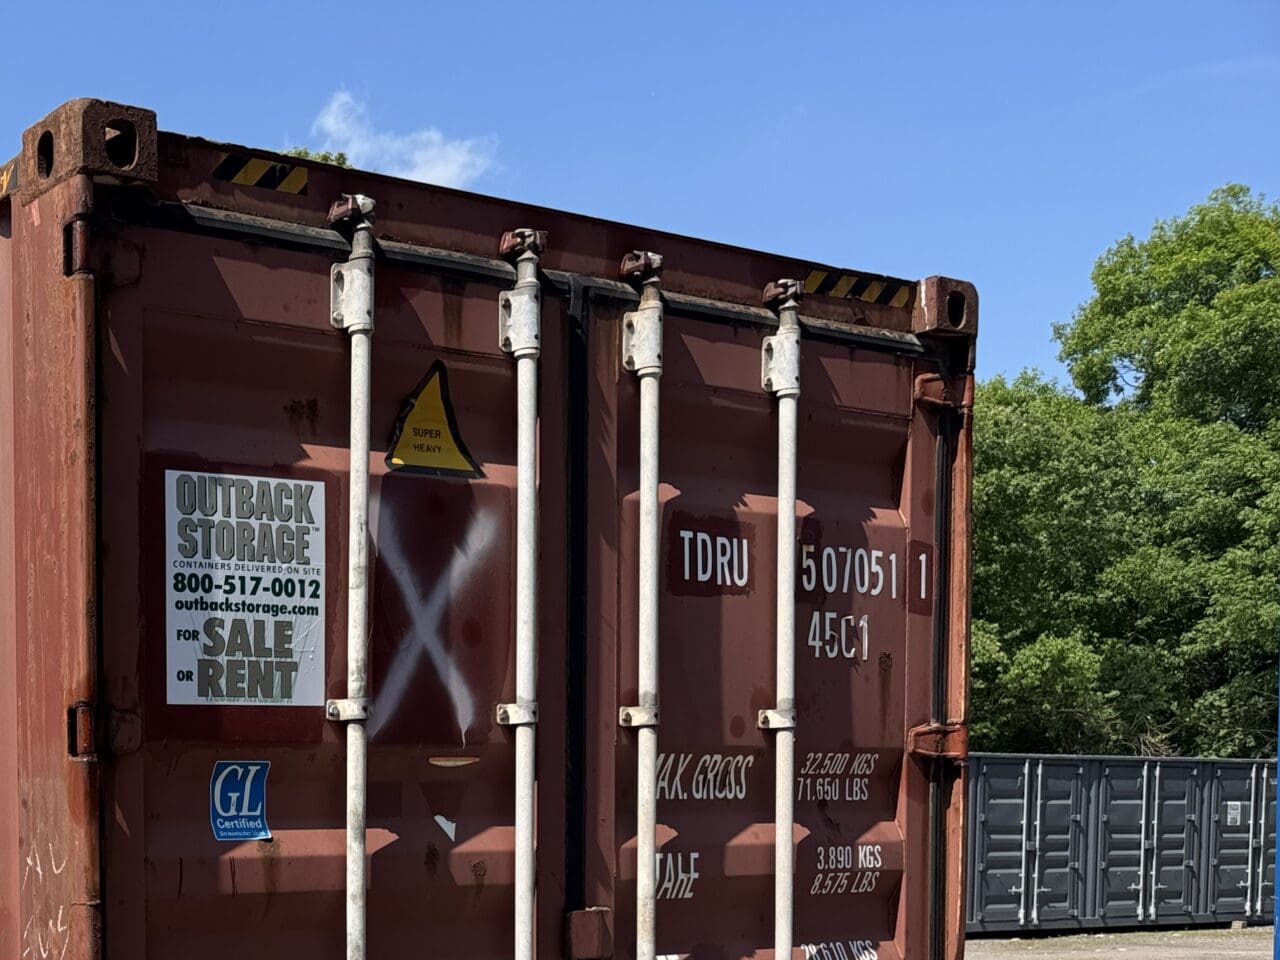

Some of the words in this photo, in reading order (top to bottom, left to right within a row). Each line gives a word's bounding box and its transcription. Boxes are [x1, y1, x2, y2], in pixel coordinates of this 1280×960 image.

[412, 427, 441, 439] SUPER
[414, 443, 442, 455] HEAVY
[176, 474, 315, 524] OUTBACK
[177, 517, 310, 565] STORAGE
[173, 560, 231, 571] CONTAINERS
[234, 563, 283, 574] DELIVERED
[287, 567, 300, 575] ON
[302, 567, 320, 576] SITE
[679, 530, 749, 587] TDRU
[801, 544, 897, 599] 507051
[919, 552, 927, 599] 1
[173, 573, 320, 599] 800-517-0012
[175, 596, 319, 617] outbackstorage.com
[177, 630, 199, 642] FOR
[202, 617, 293, 658] SALE
[176, 670, 194, 682] OR
[197, 659, 298, 699] RENT
[849, 753, 879, 775] KGS
[692, 753, 754, 800] GROSS
[214, 765, 262, 817] GL
[845, 778, 869, 801] LBS
[217, 818, 262, 829] Certified
[858, 845, 882, 869] KGS
[851, 871, 880, 893] LBS
